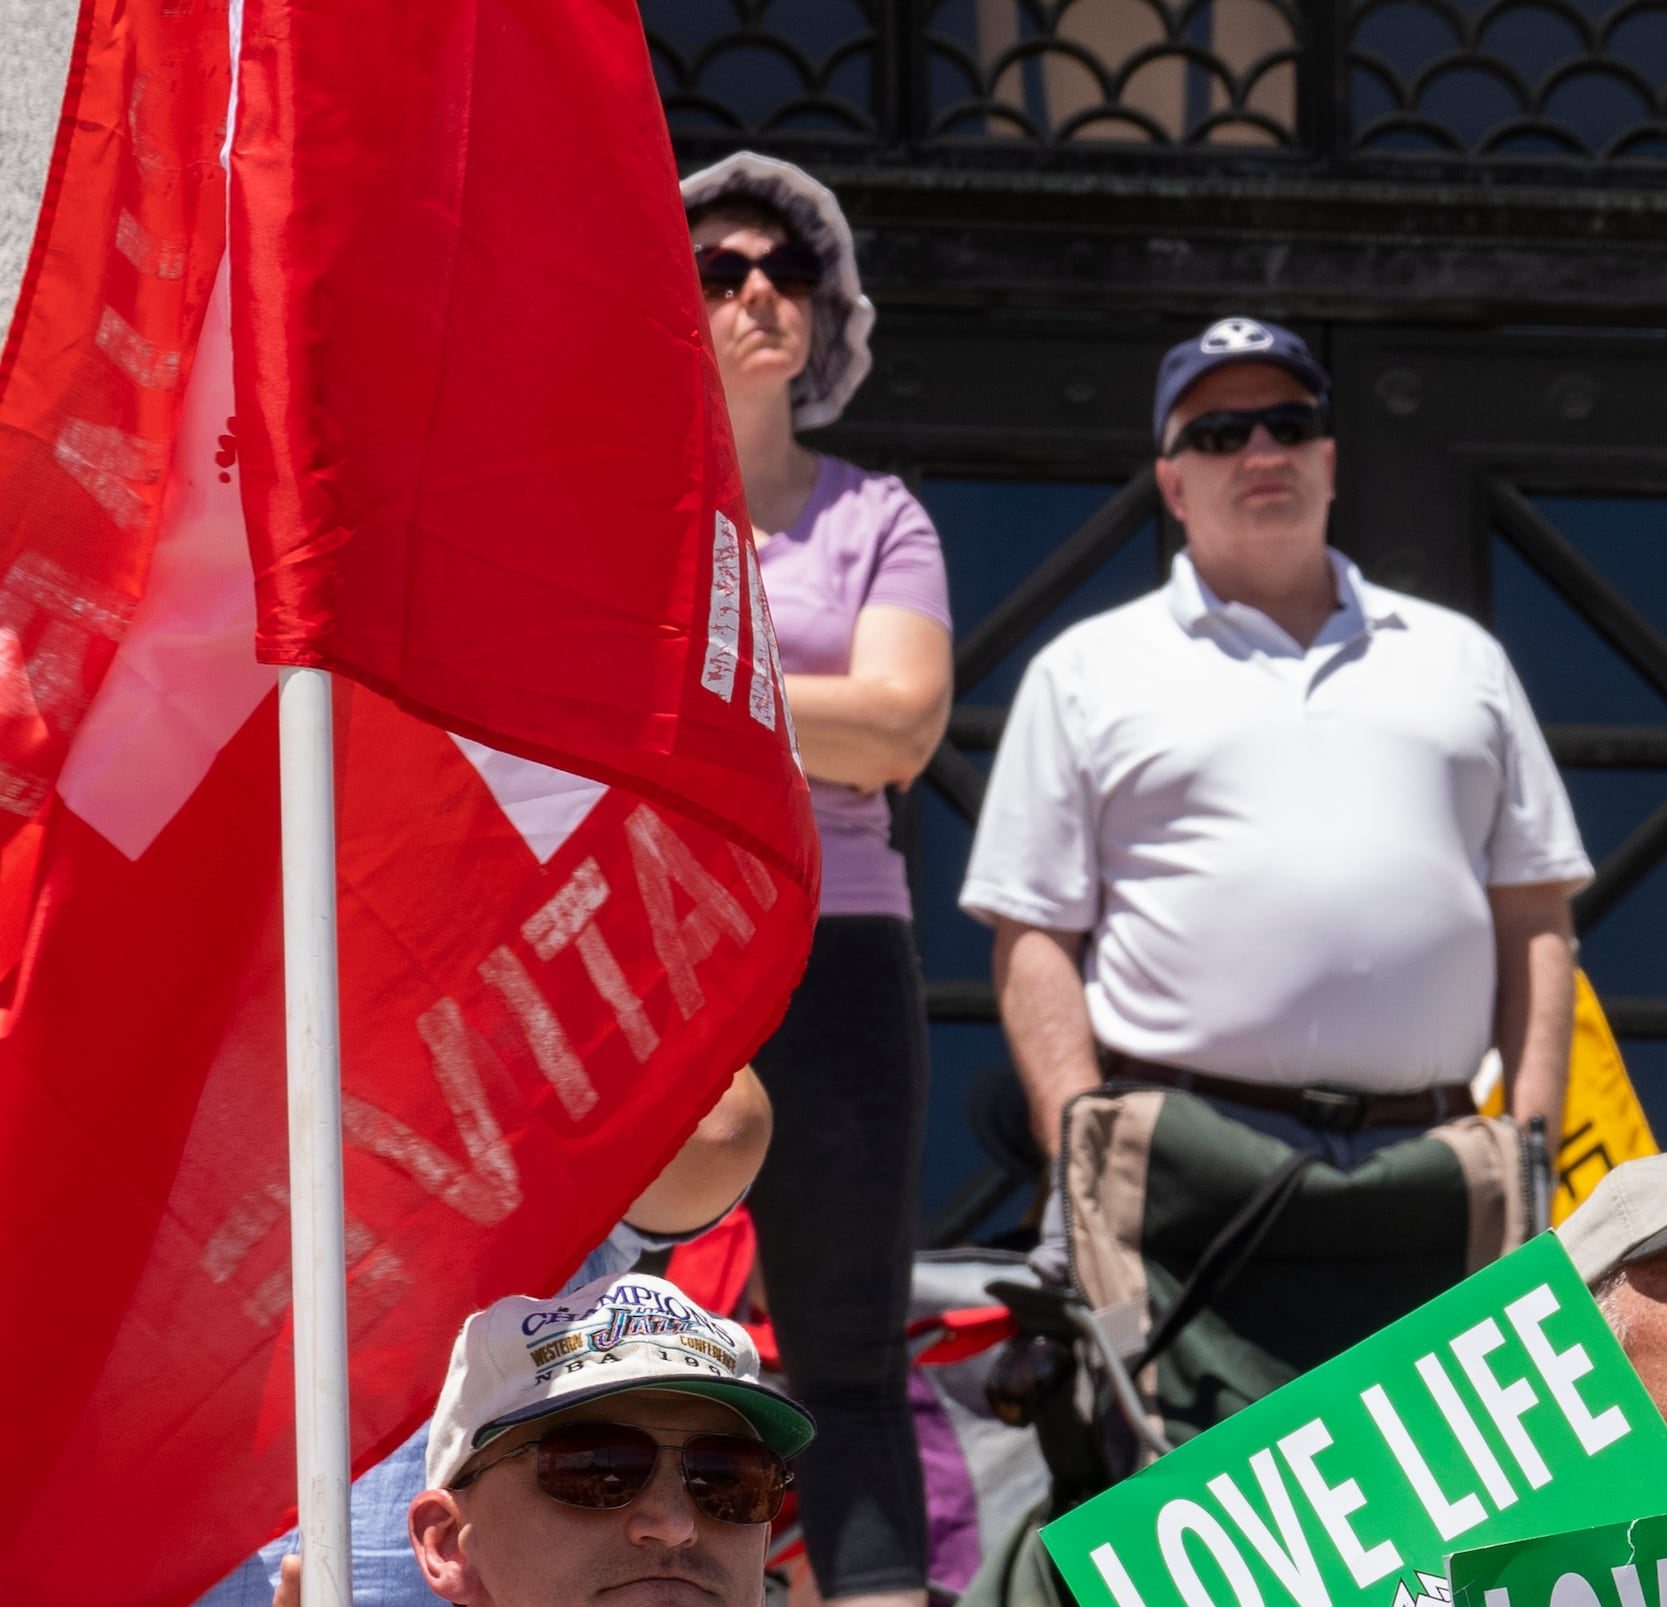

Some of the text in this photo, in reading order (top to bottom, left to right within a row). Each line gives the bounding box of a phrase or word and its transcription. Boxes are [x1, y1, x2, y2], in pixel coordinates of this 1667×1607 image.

[522, 1285, 735, 1348] CHAMPIONS
[530, 1332, 584, 1368] WESTERN
[1360, 1282, 1631, 1542] LIFE
